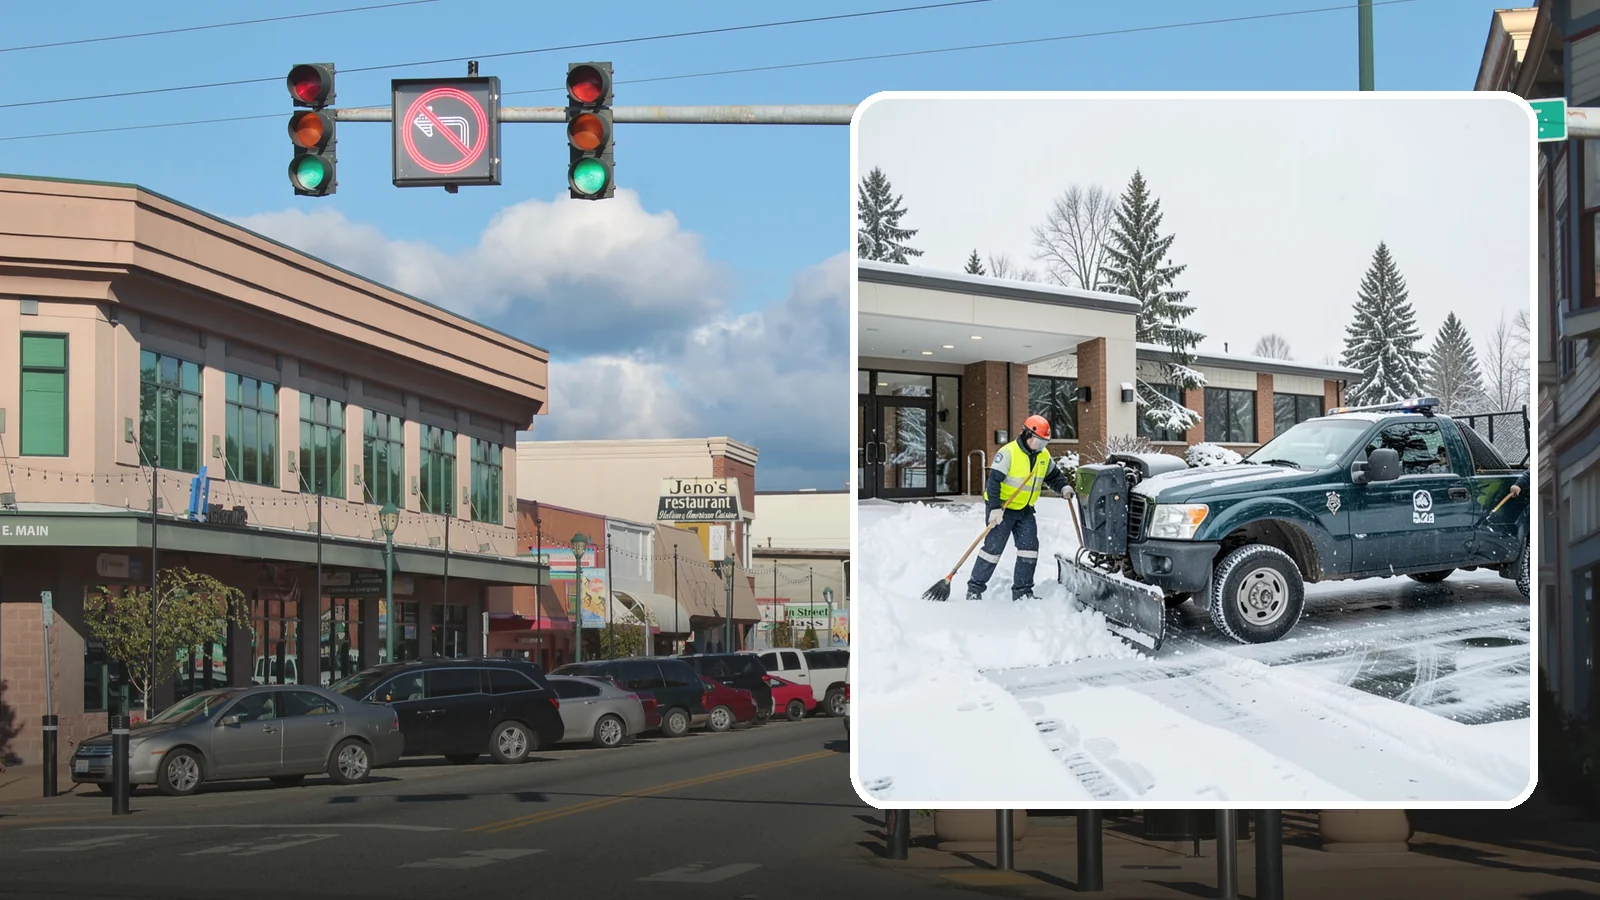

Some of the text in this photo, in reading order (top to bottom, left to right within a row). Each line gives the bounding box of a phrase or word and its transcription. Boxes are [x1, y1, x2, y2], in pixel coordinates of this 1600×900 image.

[669, 480, 727, 495] Jeno's
[665, 496, 731, 509] restaurant
[2, 525, 49, 536] E. MAIN
[797, 607, 828, 617] Street
